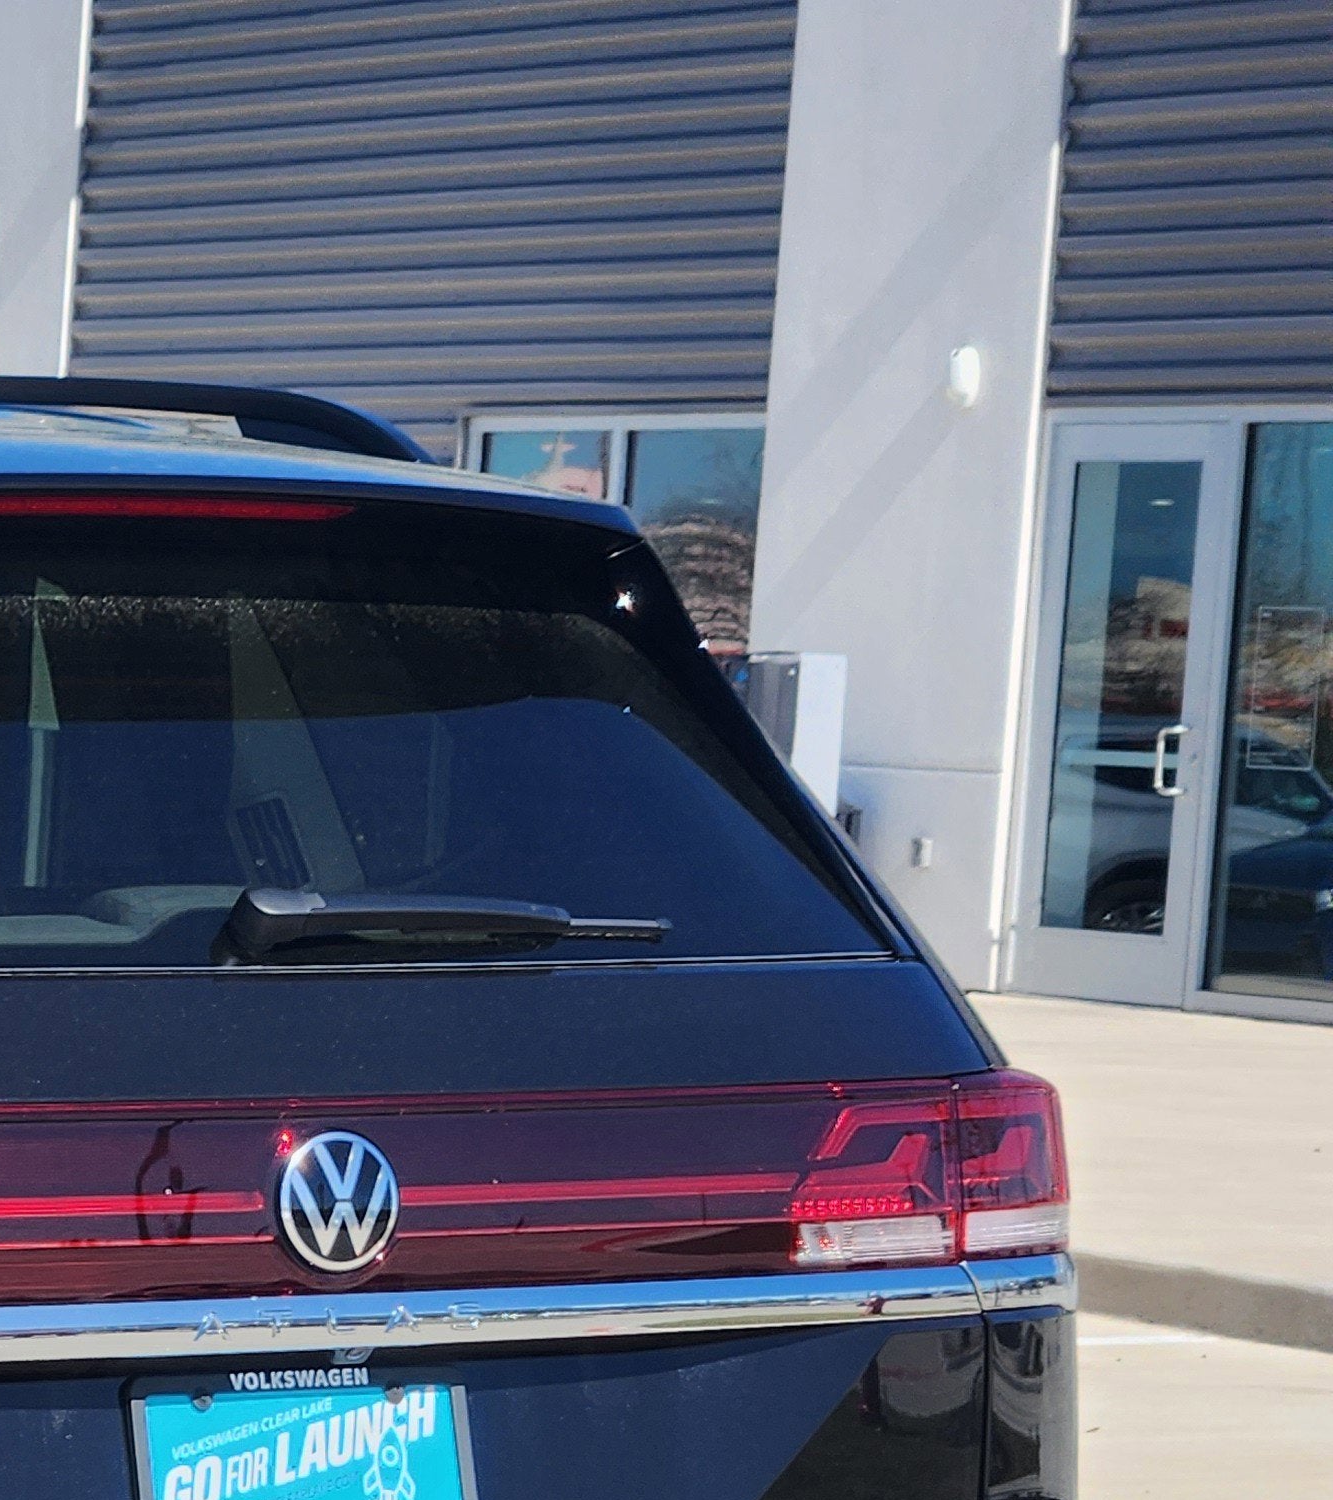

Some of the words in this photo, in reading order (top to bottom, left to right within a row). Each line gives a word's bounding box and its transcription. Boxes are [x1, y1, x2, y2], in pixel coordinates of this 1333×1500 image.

[193, 1301, 482, 1342] ATLAS
[230, 1366, 369, 1391] VOLKSWAGEN
[171, 1420, 259, 1461] VOLKSWAGEN
[259, 1407, 301, 1433] CLEAR
[301, 1396, 333, 1420] LAKE
[224, 1446, 269, 1499] FOR
[273, 1390, 438, 1487] LAUNCH
